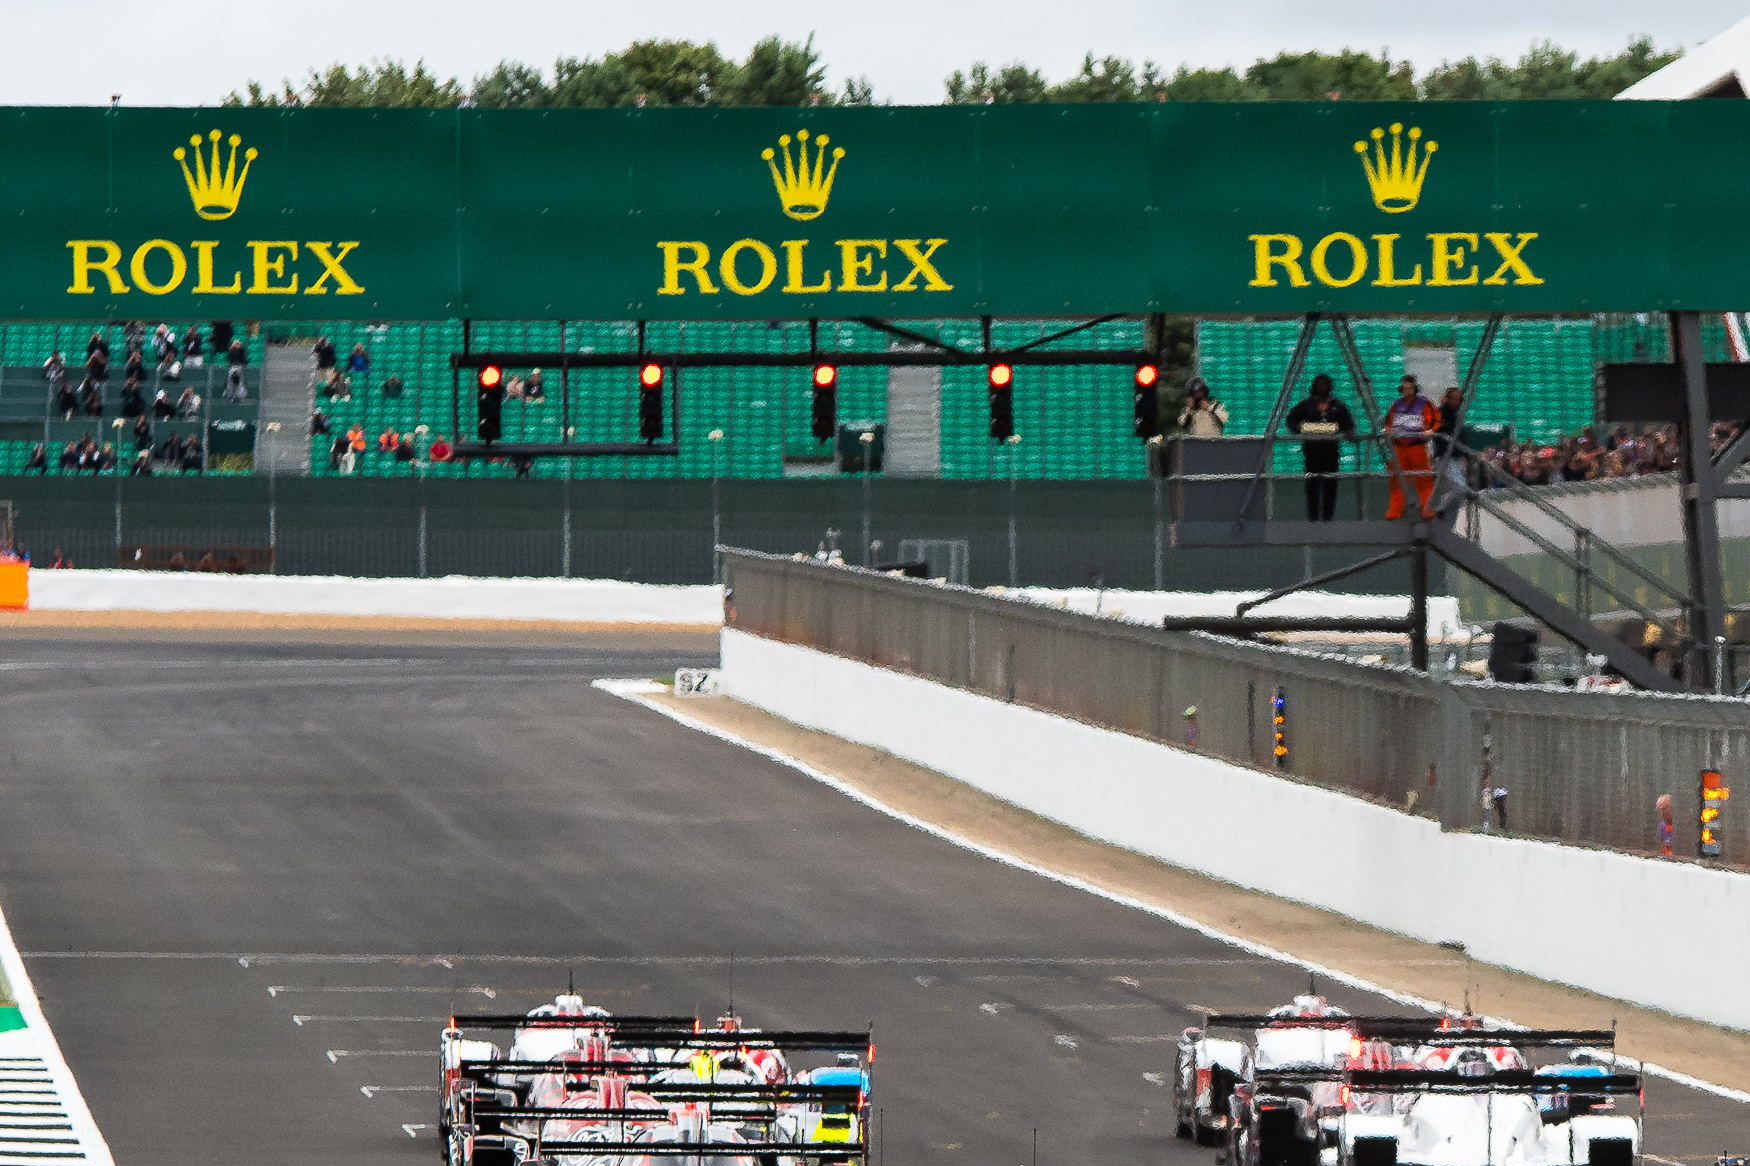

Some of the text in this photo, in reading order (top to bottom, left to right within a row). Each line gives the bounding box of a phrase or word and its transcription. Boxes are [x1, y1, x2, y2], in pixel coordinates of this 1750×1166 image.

[66, 239, 365, 295] ROLEX
[658, 238, 953, 295] ROLEX
[1250, 231, 1543, 288] ROLEX
